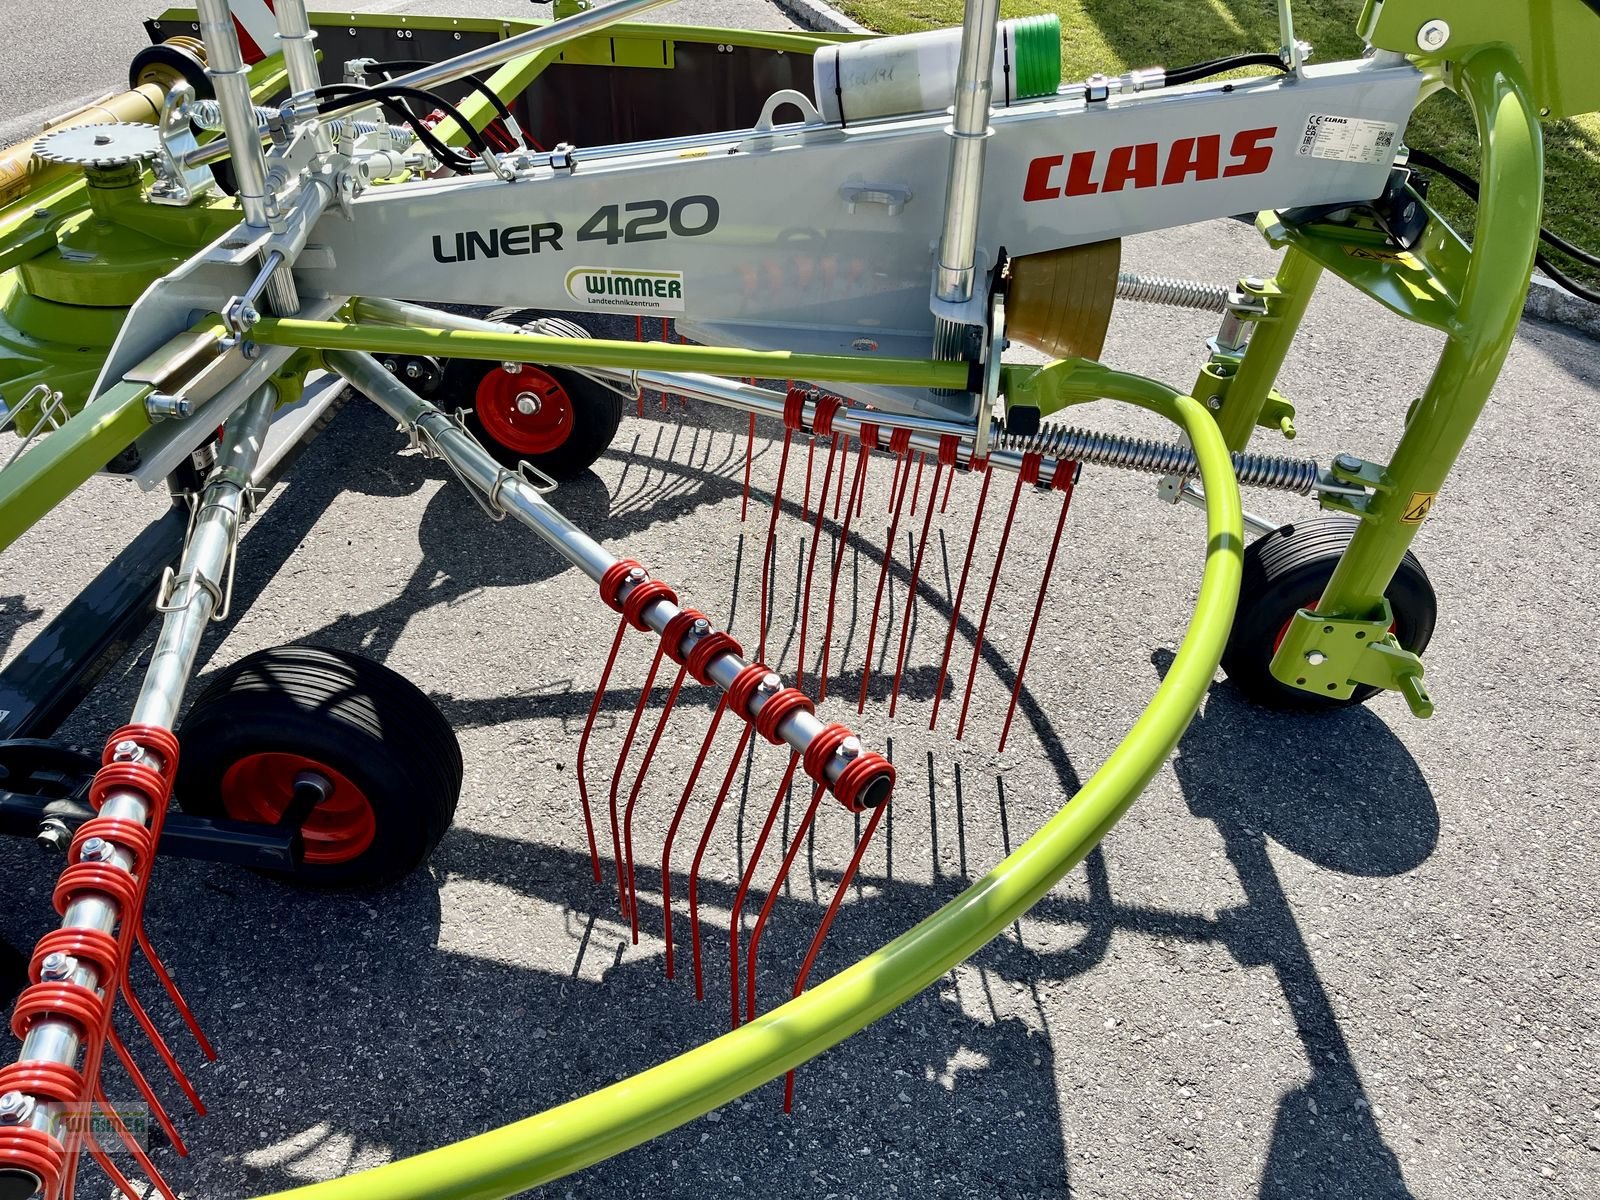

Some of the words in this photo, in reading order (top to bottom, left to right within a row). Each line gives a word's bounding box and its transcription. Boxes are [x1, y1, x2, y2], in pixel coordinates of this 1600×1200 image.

[1023, 126, 1278, 202] CLAAS
[432, 221, 564, 264] LINER
[576, 194, 720, 245] 420
[584, 275, 682, 299] WIMMER
[588, 297, 660, 308] Landtechnikzentrum
